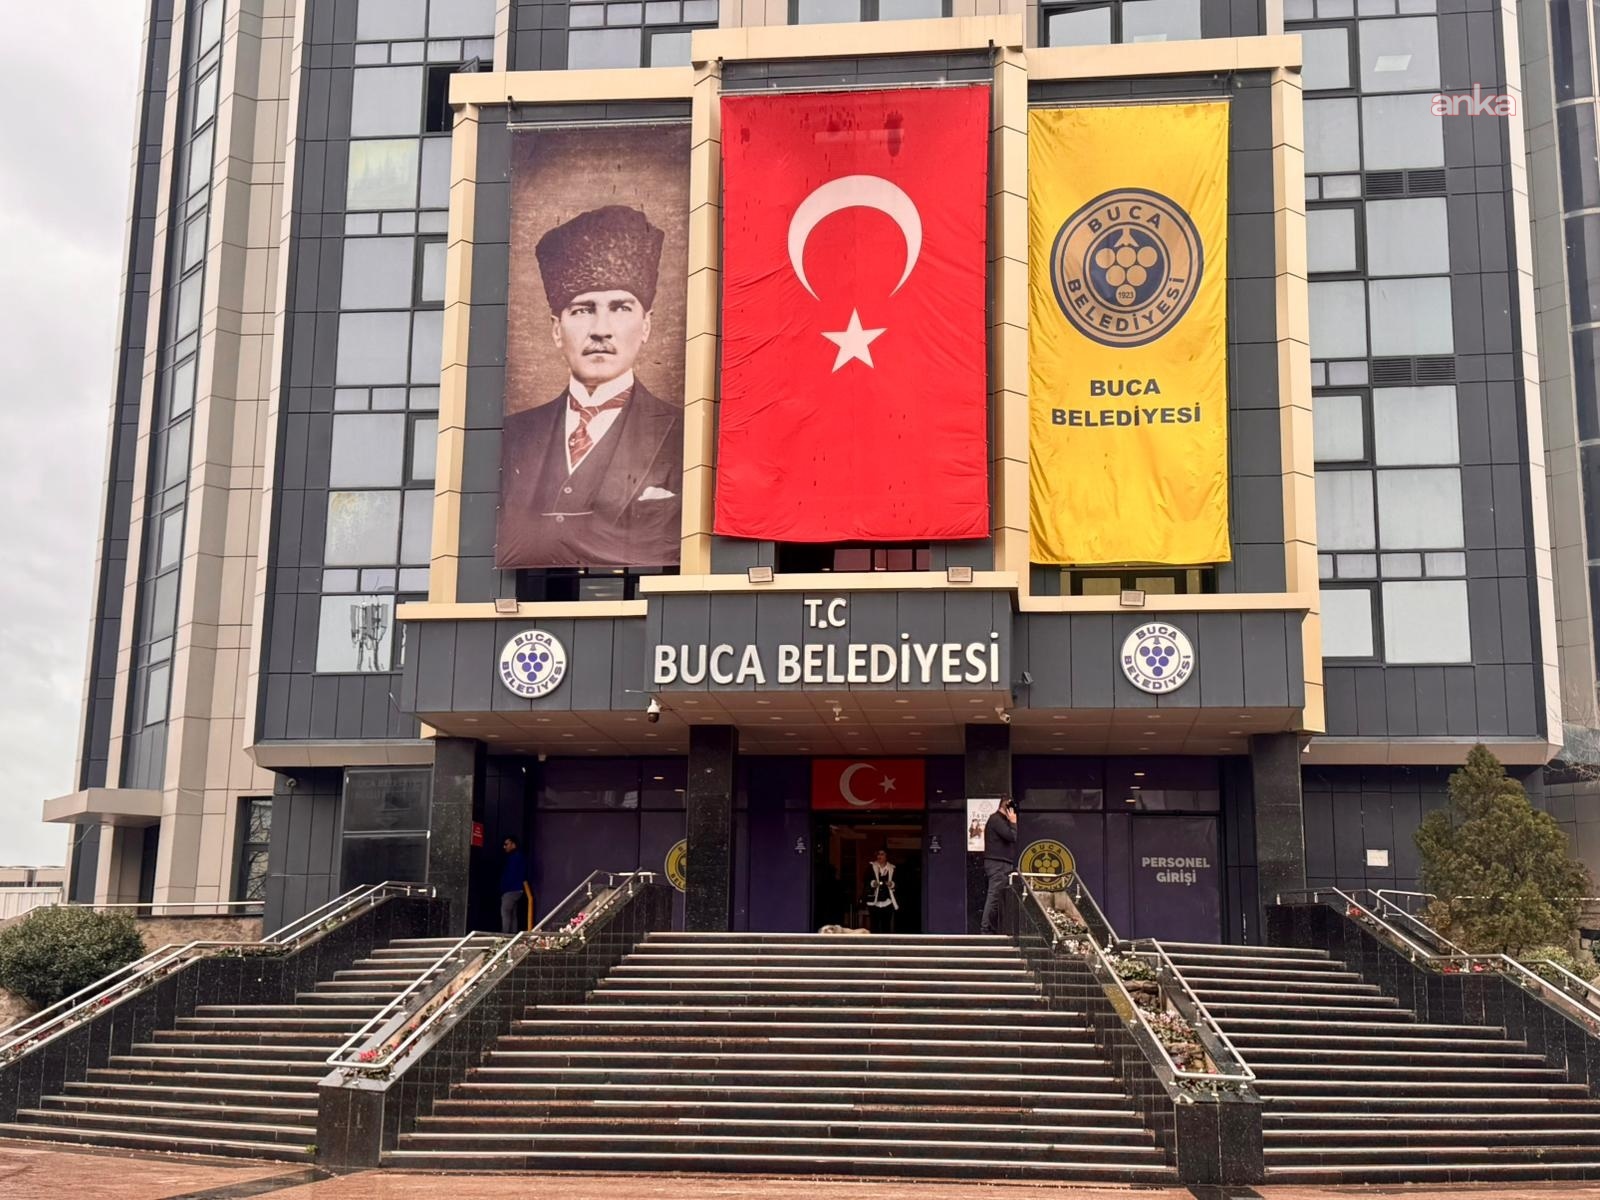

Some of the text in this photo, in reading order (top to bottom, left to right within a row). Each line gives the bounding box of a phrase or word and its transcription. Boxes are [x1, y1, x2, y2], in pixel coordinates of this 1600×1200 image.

[1087, 205, 1161, 234] BUCA
[1067, 277, 1185, 332] BELEDİYESİ
[1090, 378, 1161, 397] BUCA
[1051, 402, 1202, 427] BELEDİYESİ
[803, 597, 848, 629] T.C
[514, 633, 553, 647] BUCA
[1135, 626, 1178, 640] BUCA
[653, 631, 1000, 685] BUCA BELEDİYESİ
[1141, 856, 1211, 868] PERSONEL
[1155, 868, 1197, 886] GİRİŞİ
